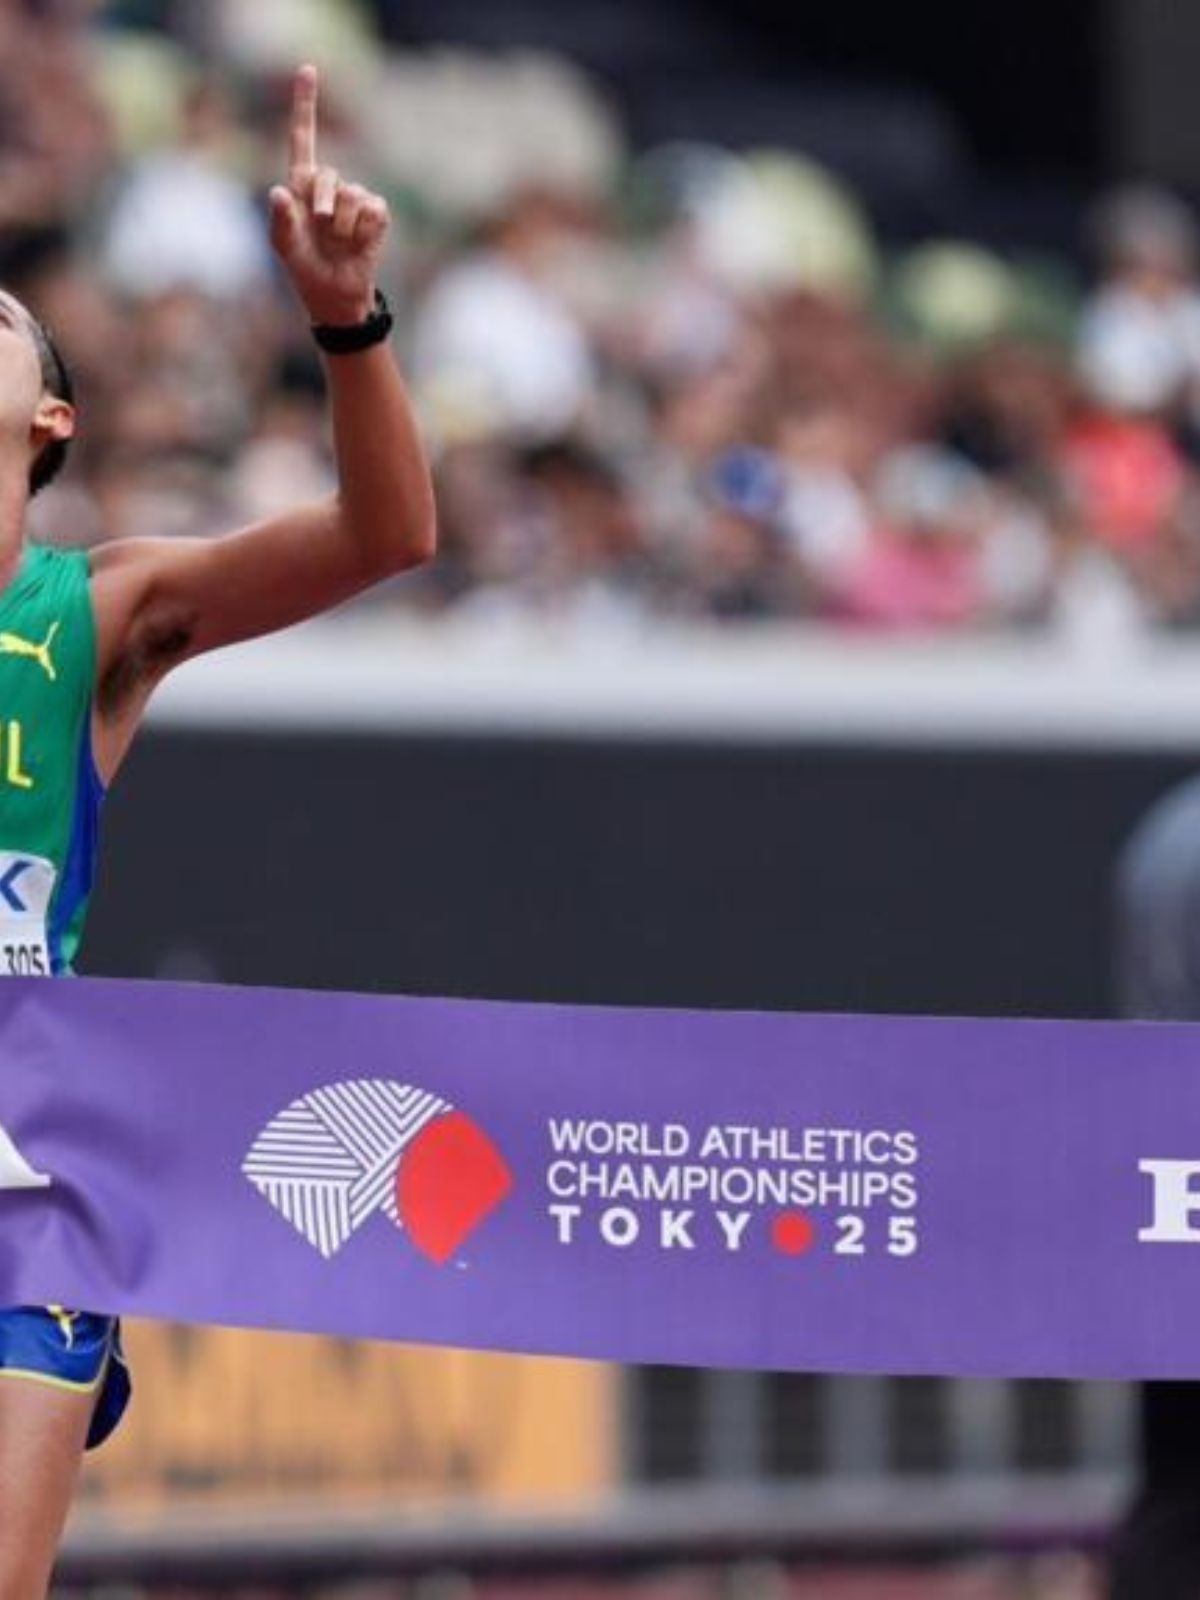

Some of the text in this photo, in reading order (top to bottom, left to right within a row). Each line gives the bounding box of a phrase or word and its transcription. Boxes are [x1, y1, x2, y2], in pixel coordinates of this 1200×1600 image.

[548, 1117, 919, 1164] WORLD ATHLETICS
[546, 1161, 919, 1209] CHAMPIONSHIPS
